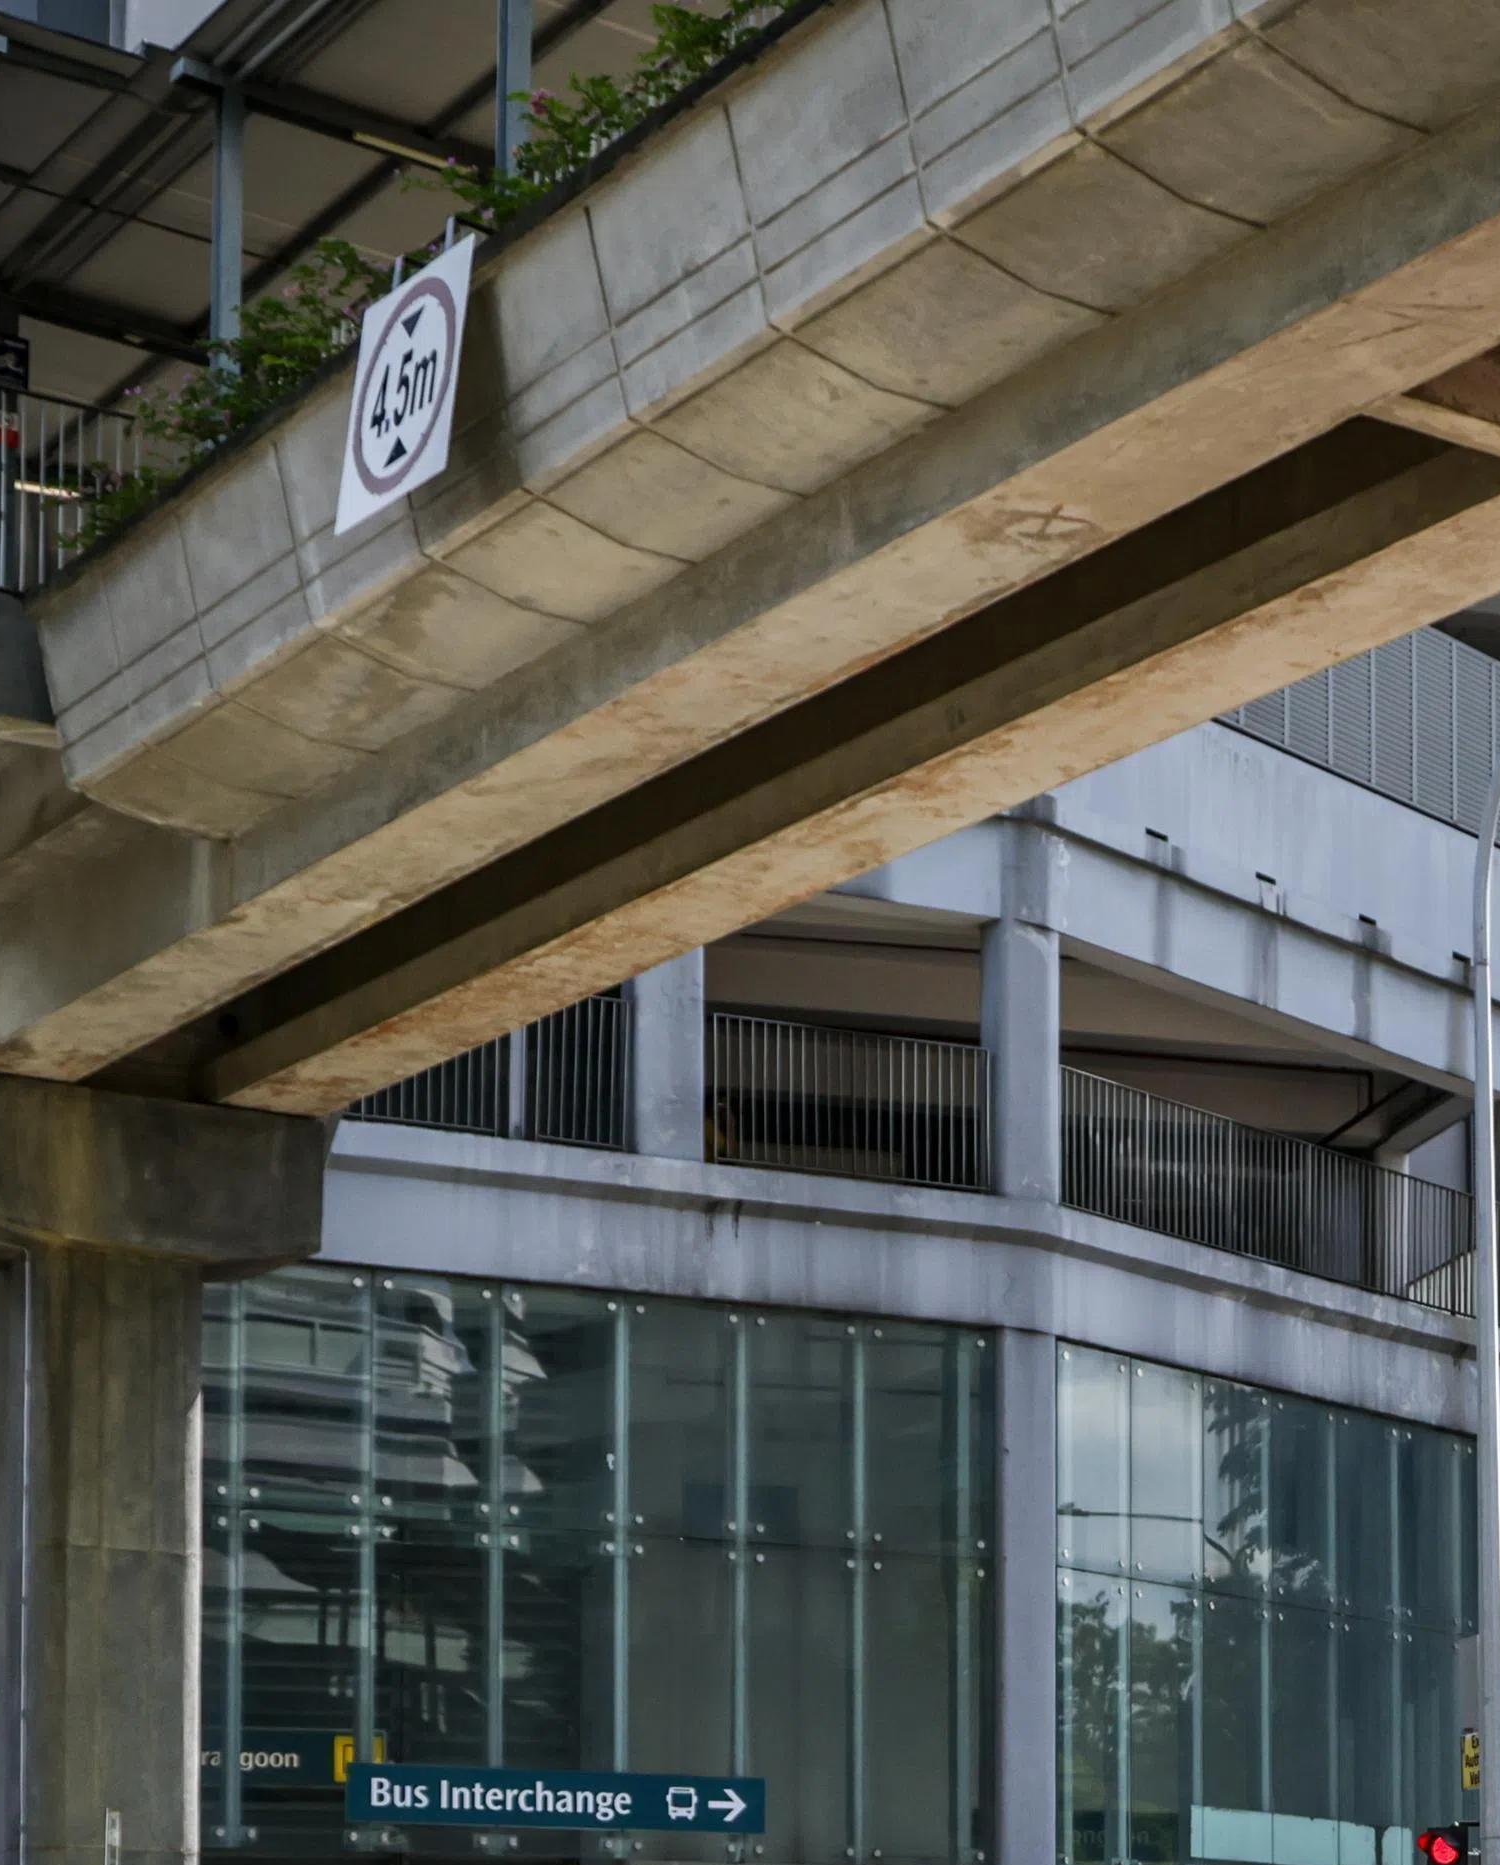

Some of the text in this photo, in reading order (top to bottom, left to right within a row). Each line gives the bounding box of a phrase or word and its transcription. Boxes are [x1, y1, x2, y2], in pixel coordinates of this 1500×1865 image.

[370, 348, 437, 438] 4.5m
[370, 1776, 632, 1821] Bus Interchange
